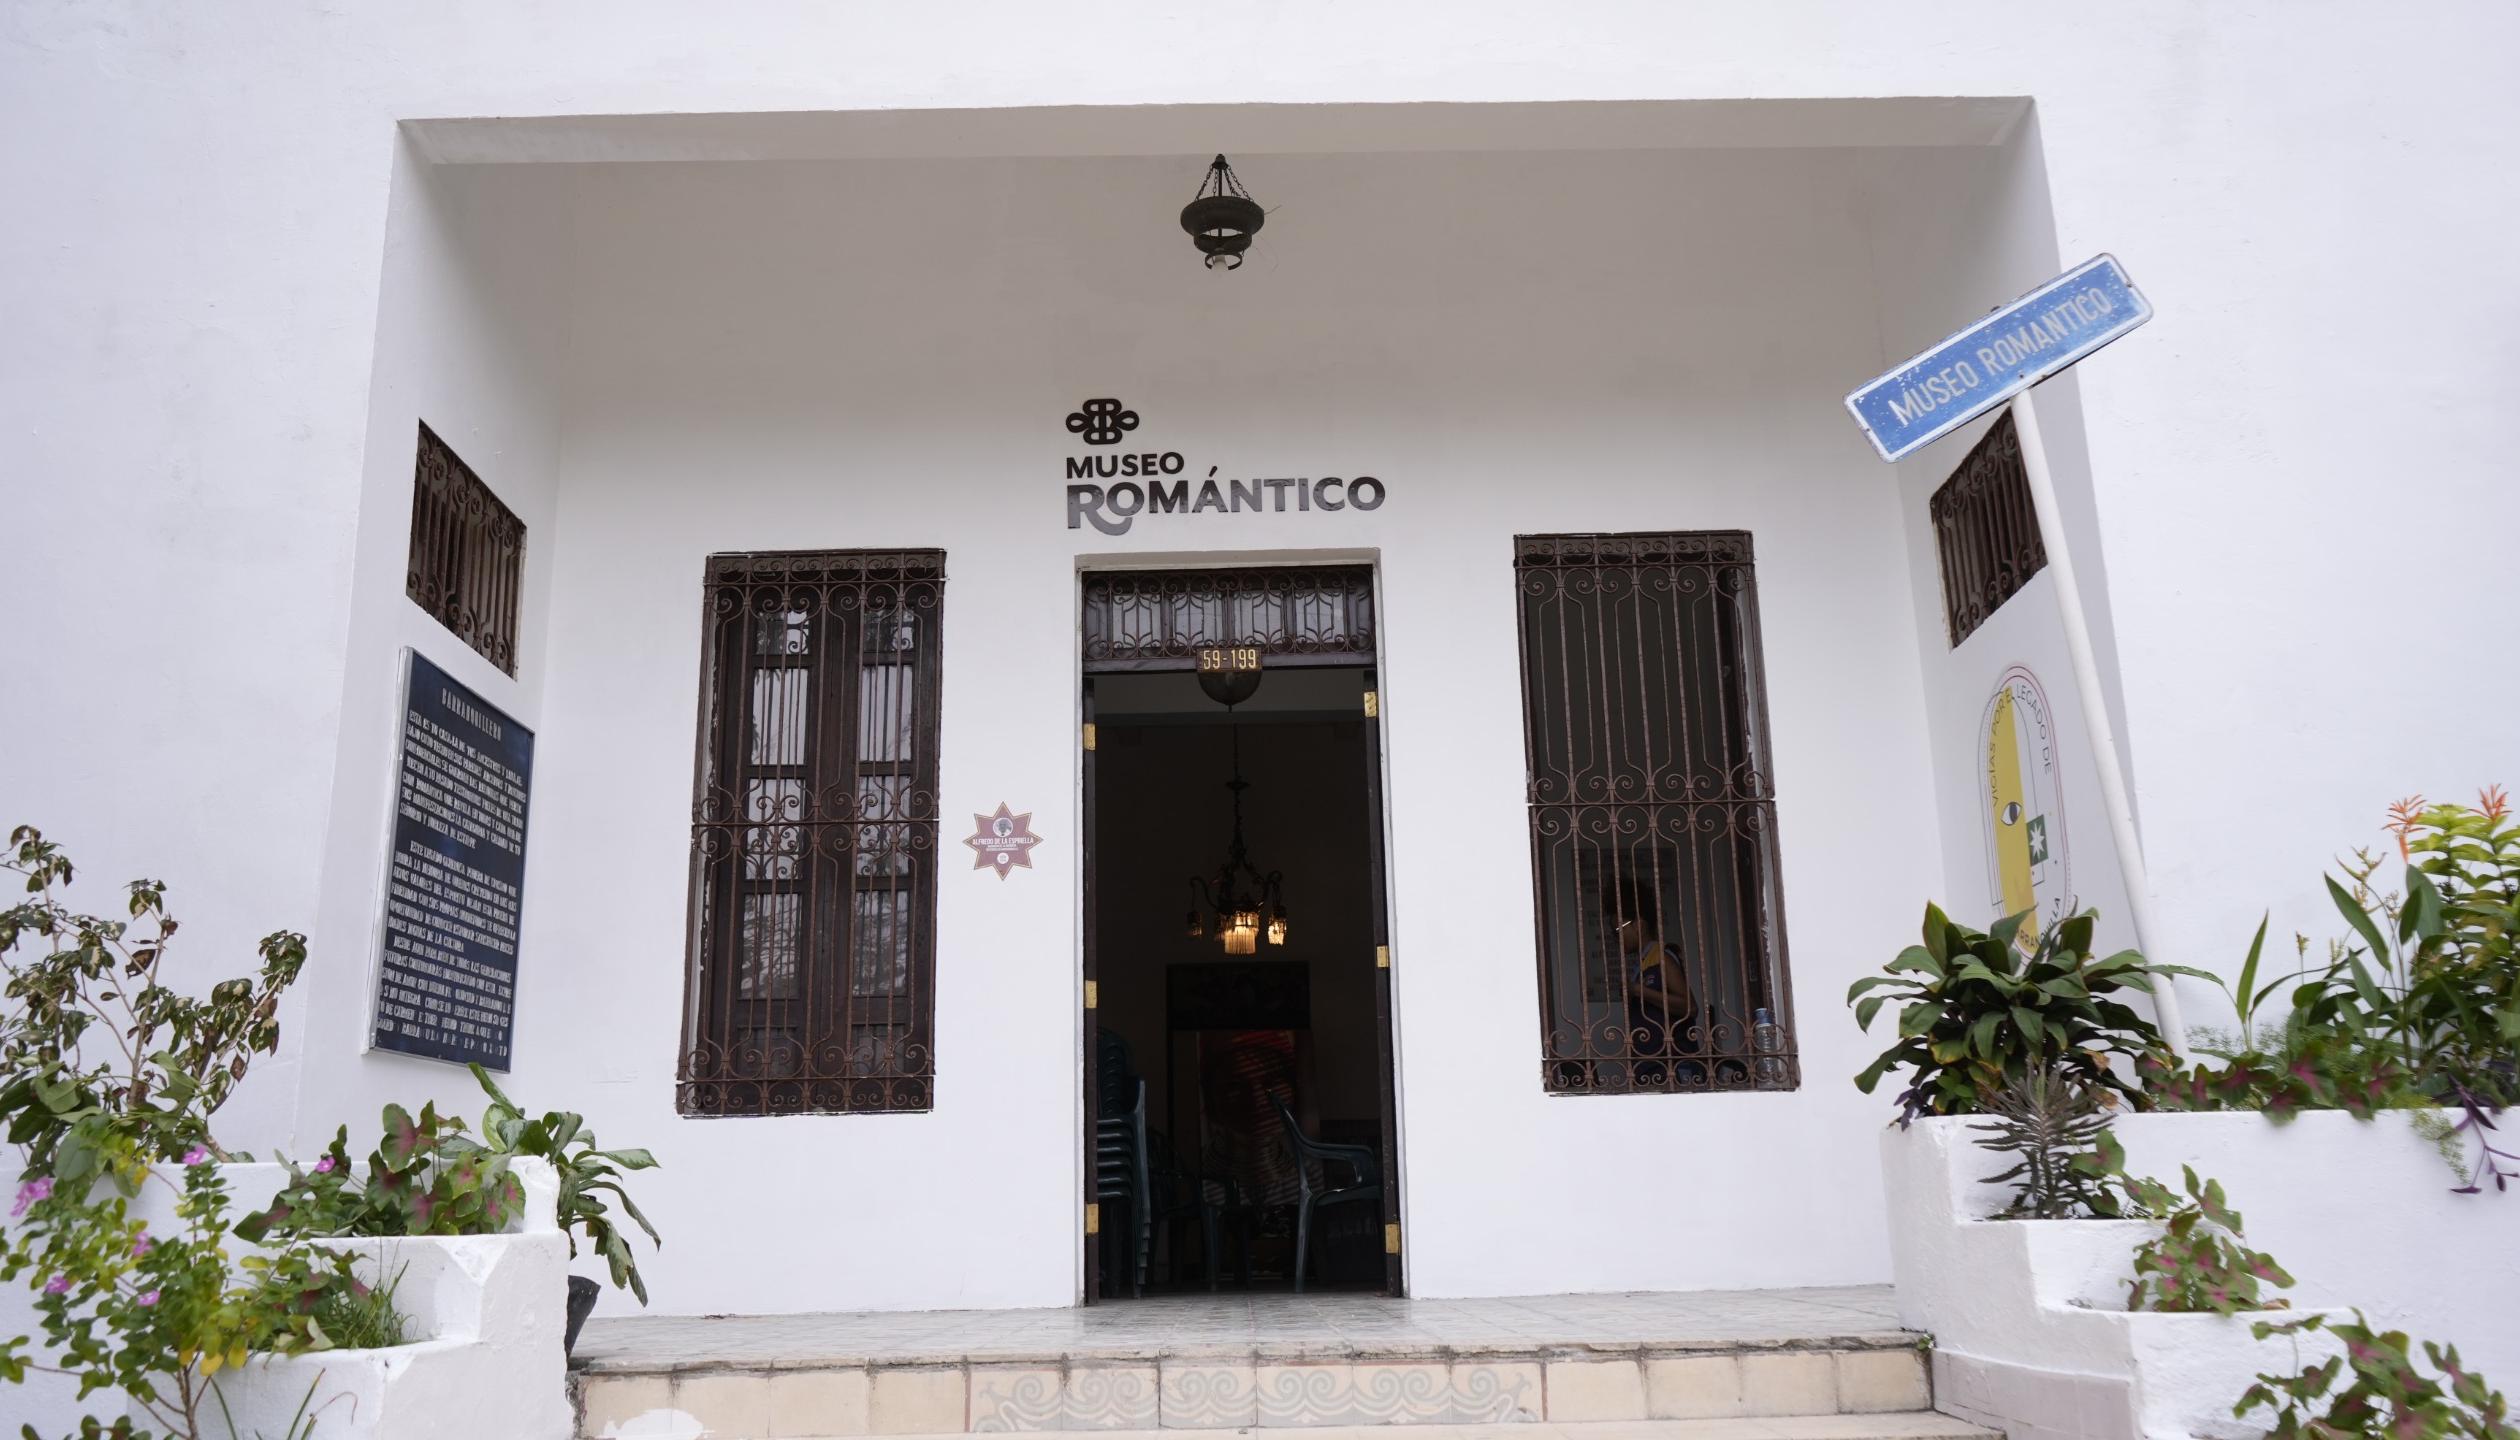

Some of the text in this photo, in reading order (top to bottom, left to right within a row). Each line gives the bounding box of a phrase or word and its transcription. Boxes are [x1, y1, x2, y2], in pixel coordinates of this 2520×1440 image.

[1888, 287, 2113, 427] MUSEO ROMANTICO
[1066, 451, 1185, 479] MUSEO
[1066, 466, 1386, 536] ROMÁNTICO
[1202, 648, 1257, 670] 59-199
[1991, 698, 2006, 737] POR
[2016, 683, 2047, 740] LEGADO
[1988, 743, 1999, 807] VIGIAS
[2042, 746, 2052, 775] DE
